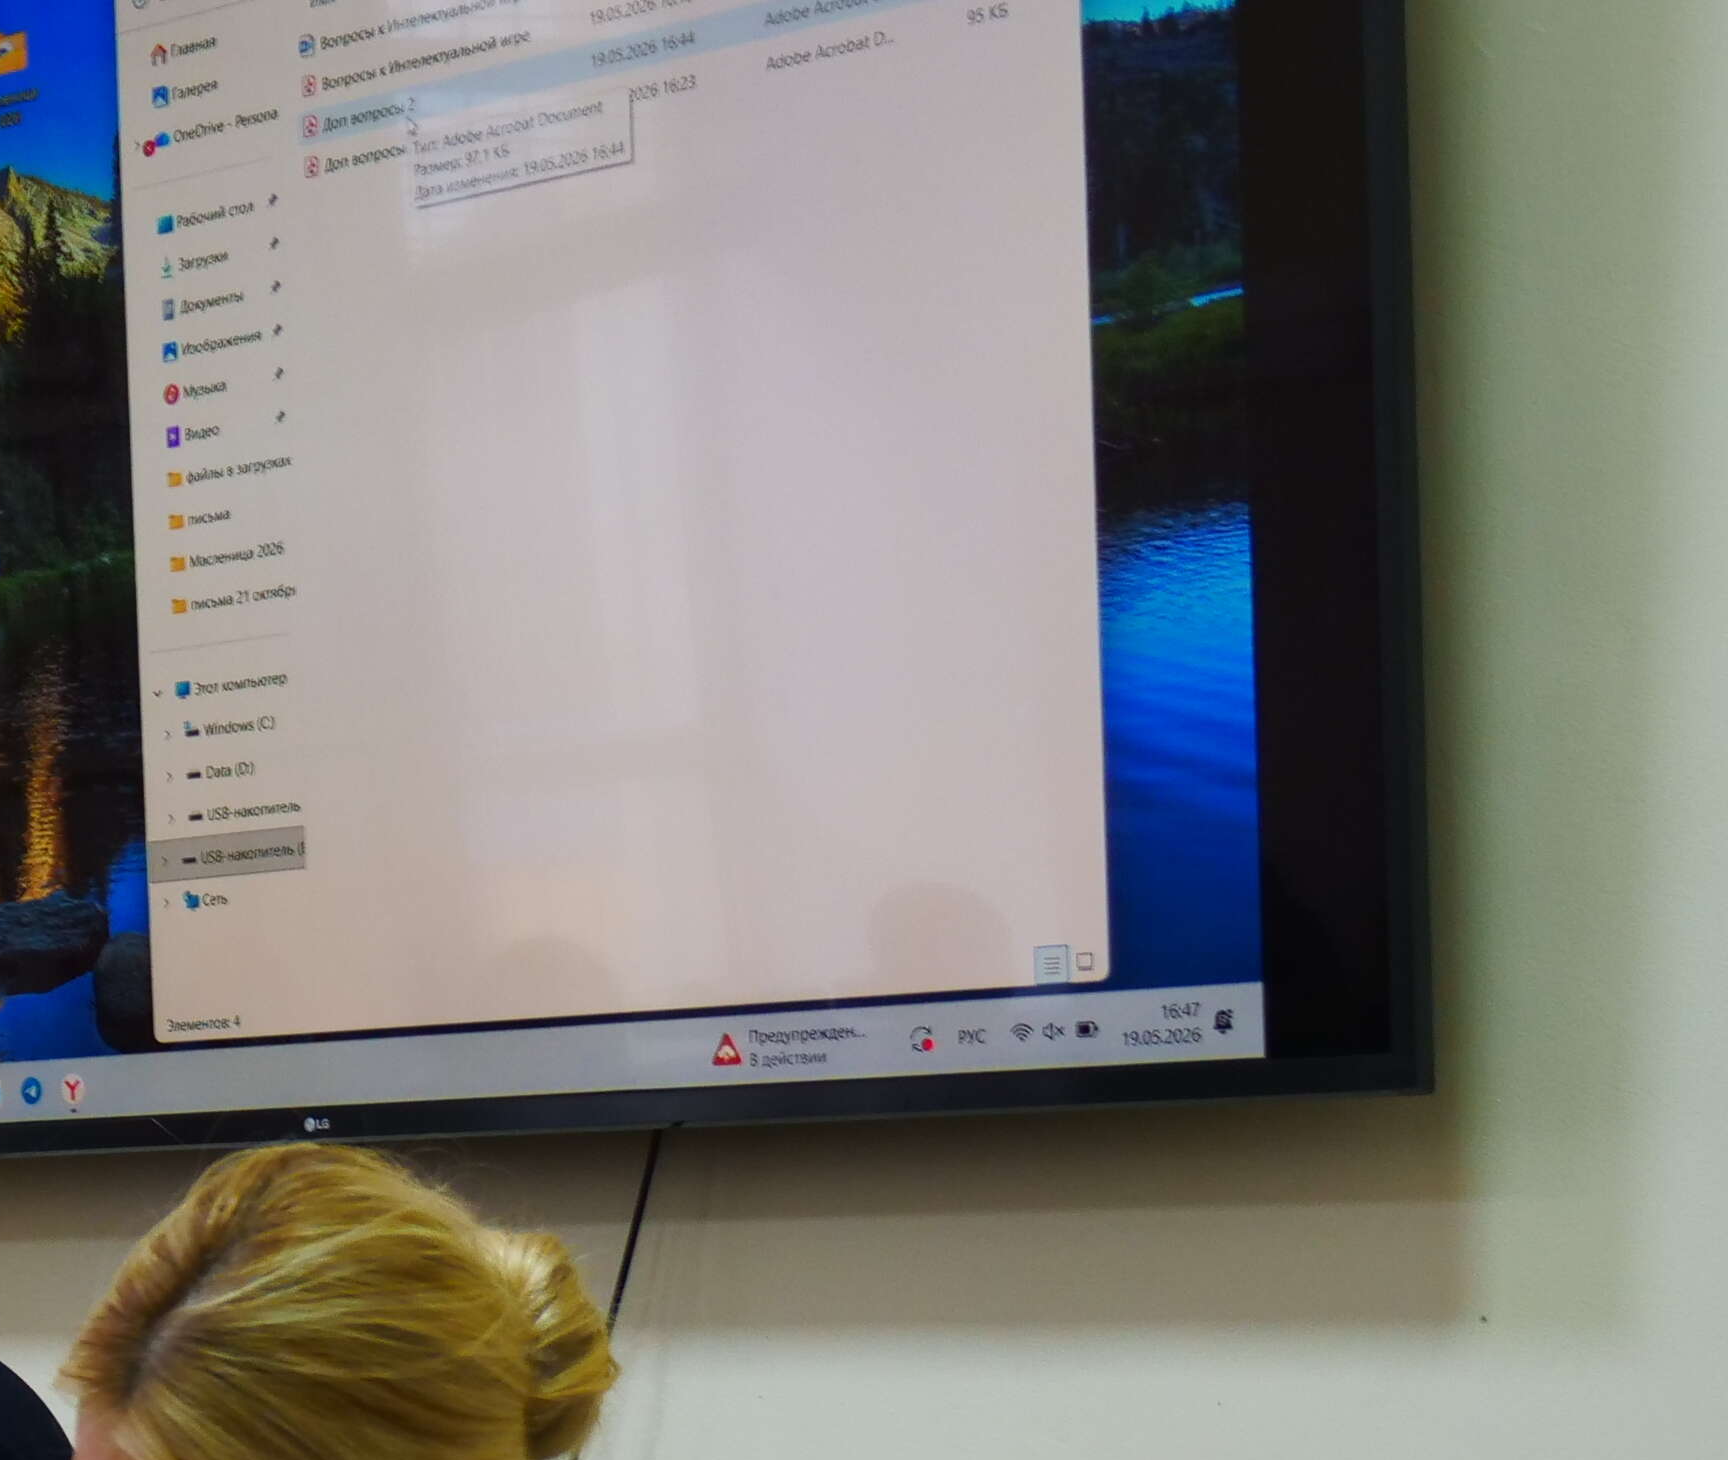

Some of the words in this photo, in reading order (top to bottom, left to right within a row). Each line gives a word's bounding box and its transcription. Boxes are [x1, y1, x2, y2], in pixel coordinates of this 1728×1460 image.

[764, 6, 810, 26] Adobe
[170, 36, 217, 56] Главная
[591, 41, 658, 68] 19.05.2026
[766, 50, 812, 71] Adobe
[815, 36, 870, 59] Acrobat
[172, 79, 218, 100] Галерея
[321, 69, 376, 90] Вопросы
[351, 103, 405, 127] вопросы
[537, 101, 604, 128] Document
[173, 121, 224, 144] OneDrive
[176, 205, 226, 228] Рабочий
[228, 201, 255, 217] стол
[178, 251, 229, 273] Загрузки
[180, 291, 244, 314] Документы
[184, 425, 221, 442] Видео
[188, 509, 232, 527] письма
[194, 681, 219, 697] Этот
[221, 672, 288, 693] компьютер
[203, 718, 255, 737] Windows
[205, 765, 232, 780] Data
[201, 890, 229, 908] Сеть
[1161, 1001, 1203, 1020] 16:47
[957, 1028, 988, 1045] РУС
[1121, 1026, 1203, 1047] 19.05.2026
[761, 1051, 828, 1069] действии
